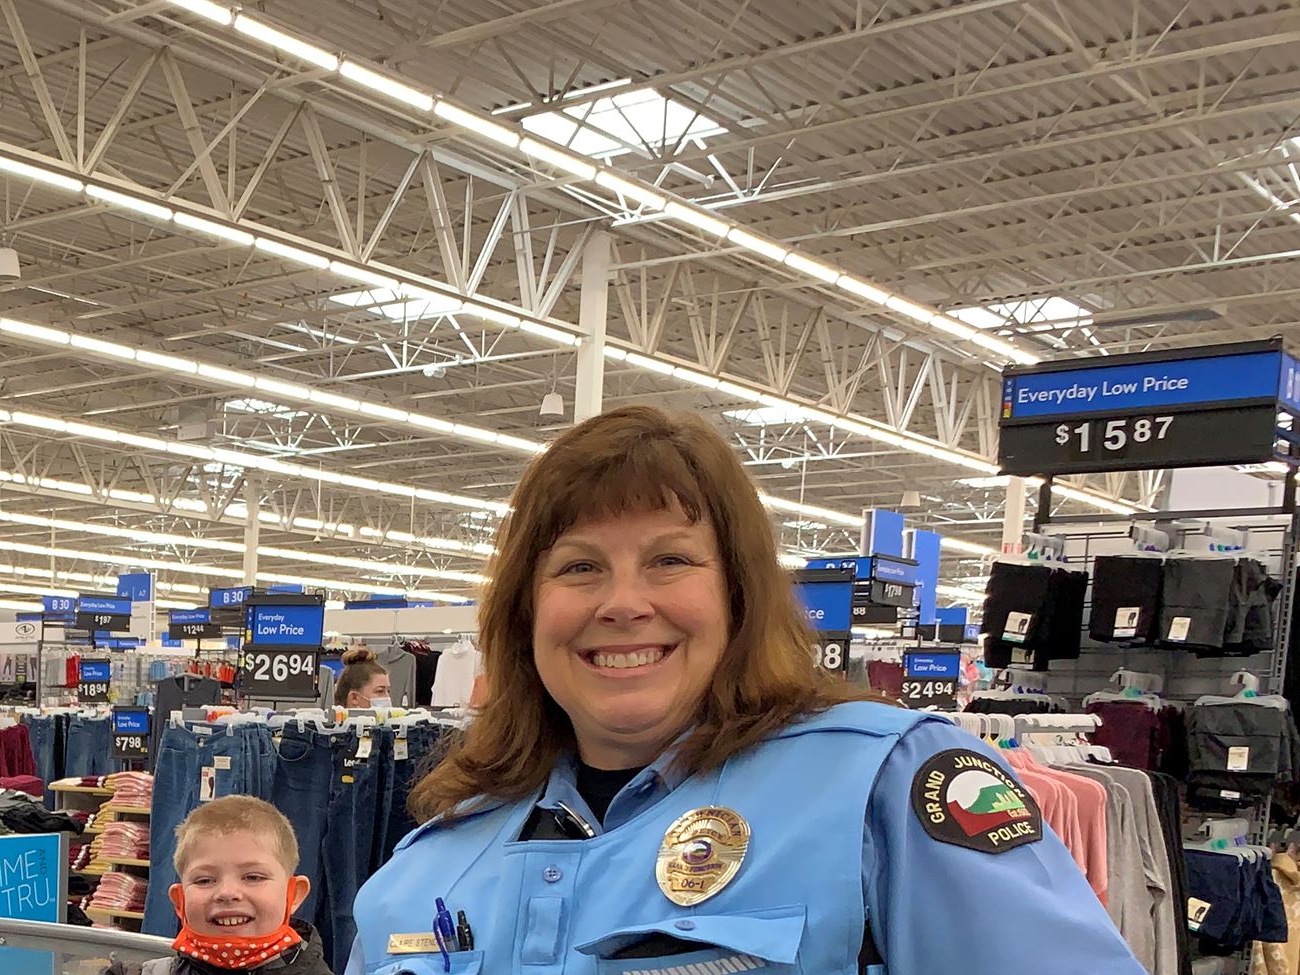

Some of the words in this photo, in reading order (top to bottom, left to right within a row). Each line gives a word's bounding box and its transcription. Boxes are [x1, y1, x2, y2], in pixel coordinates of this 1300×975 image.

[1017, 384, 1098, 405] Everyday
[1102, 380, 1138, 397] Low
[1143, 375, 1189, 392] Price
[1055, 416, 1175, 453] $1587
[51, 599, 58, 610] B
[59, 599, 70, 610] 30
[223, 592, 230, 604] B
[231, 590, 244, 602] 30
[258, 613, 285, 623] Everyday
[257, 623, 275, 635] Low
[280, 623, 304, 636] Price
[245, 652, 314, 682] $2694
[913, 664, 928, 672] Low
[928, 663, 948, 672] Price
[77, 683, 107, 697] $1894
[901, 681, 953, 700] $2494
[115, 736, 141, 752] $798
[924, 770, 946, 825] GRAND
[953, 756, 1026, 798] JUNCTION
[987, 821, 1036, 846] POLICE
[1, 877, 51, 916] TRU
